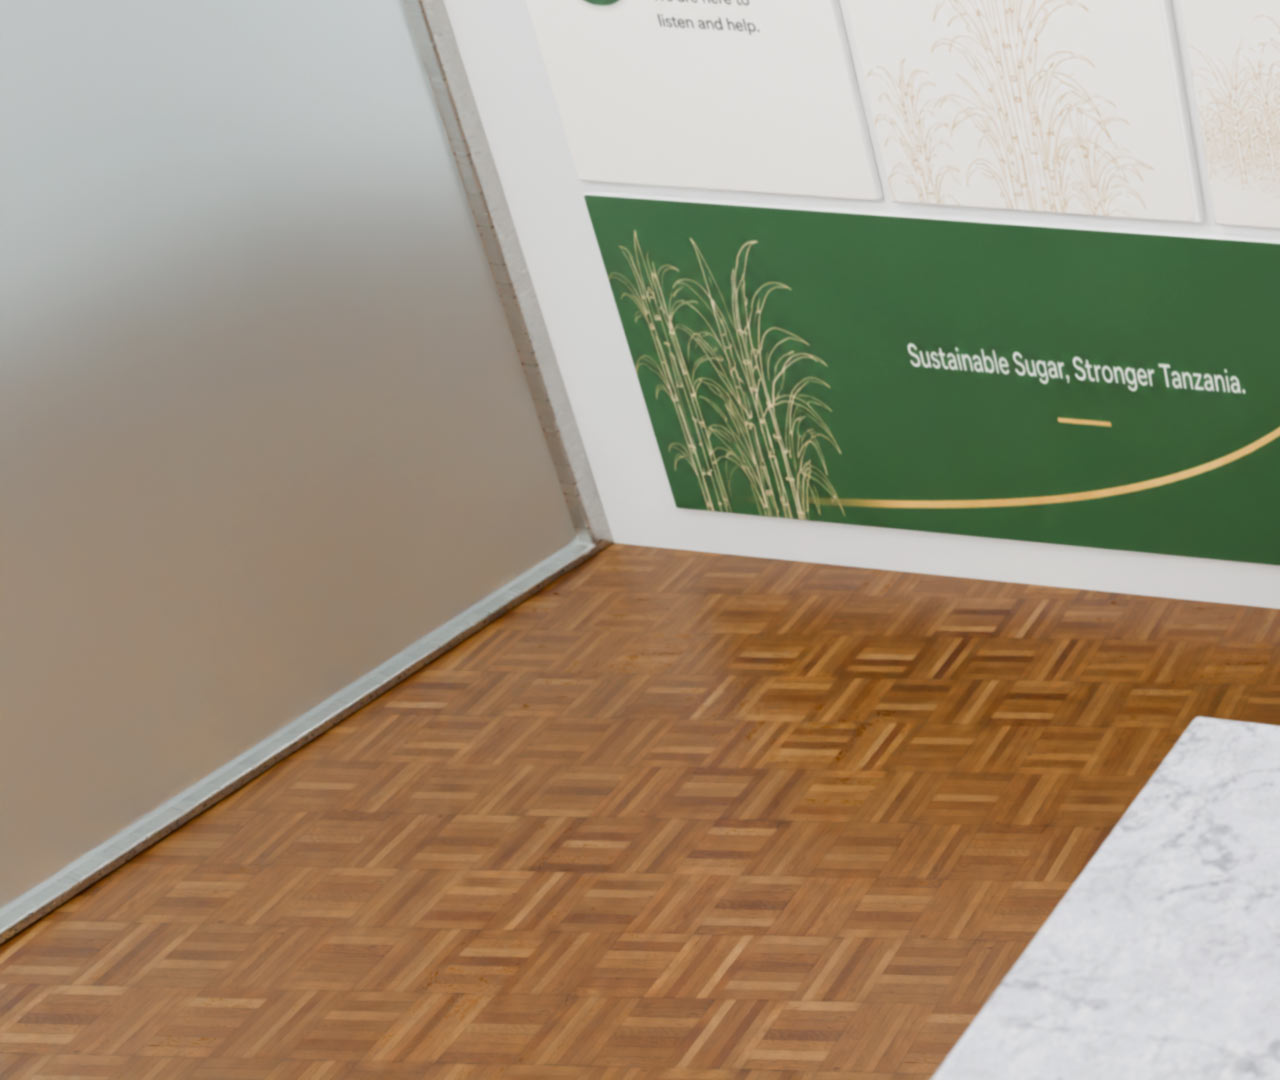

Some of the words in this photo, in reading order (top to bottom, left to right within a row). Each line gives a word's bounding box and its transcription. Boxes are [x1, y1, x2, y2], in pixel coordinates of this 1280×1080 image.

[657, 14, 694, 29] listen
[698, 18, 723, 30] and
[726, 18, 760, 35] help.
[907, 343, 1010, 375] Sustainable
[1012, 351, 1070, 384] Sugar,
[1072, 356, 1155, 392] Stronger
[1158, 363, 1246, 394] Tanzania.
